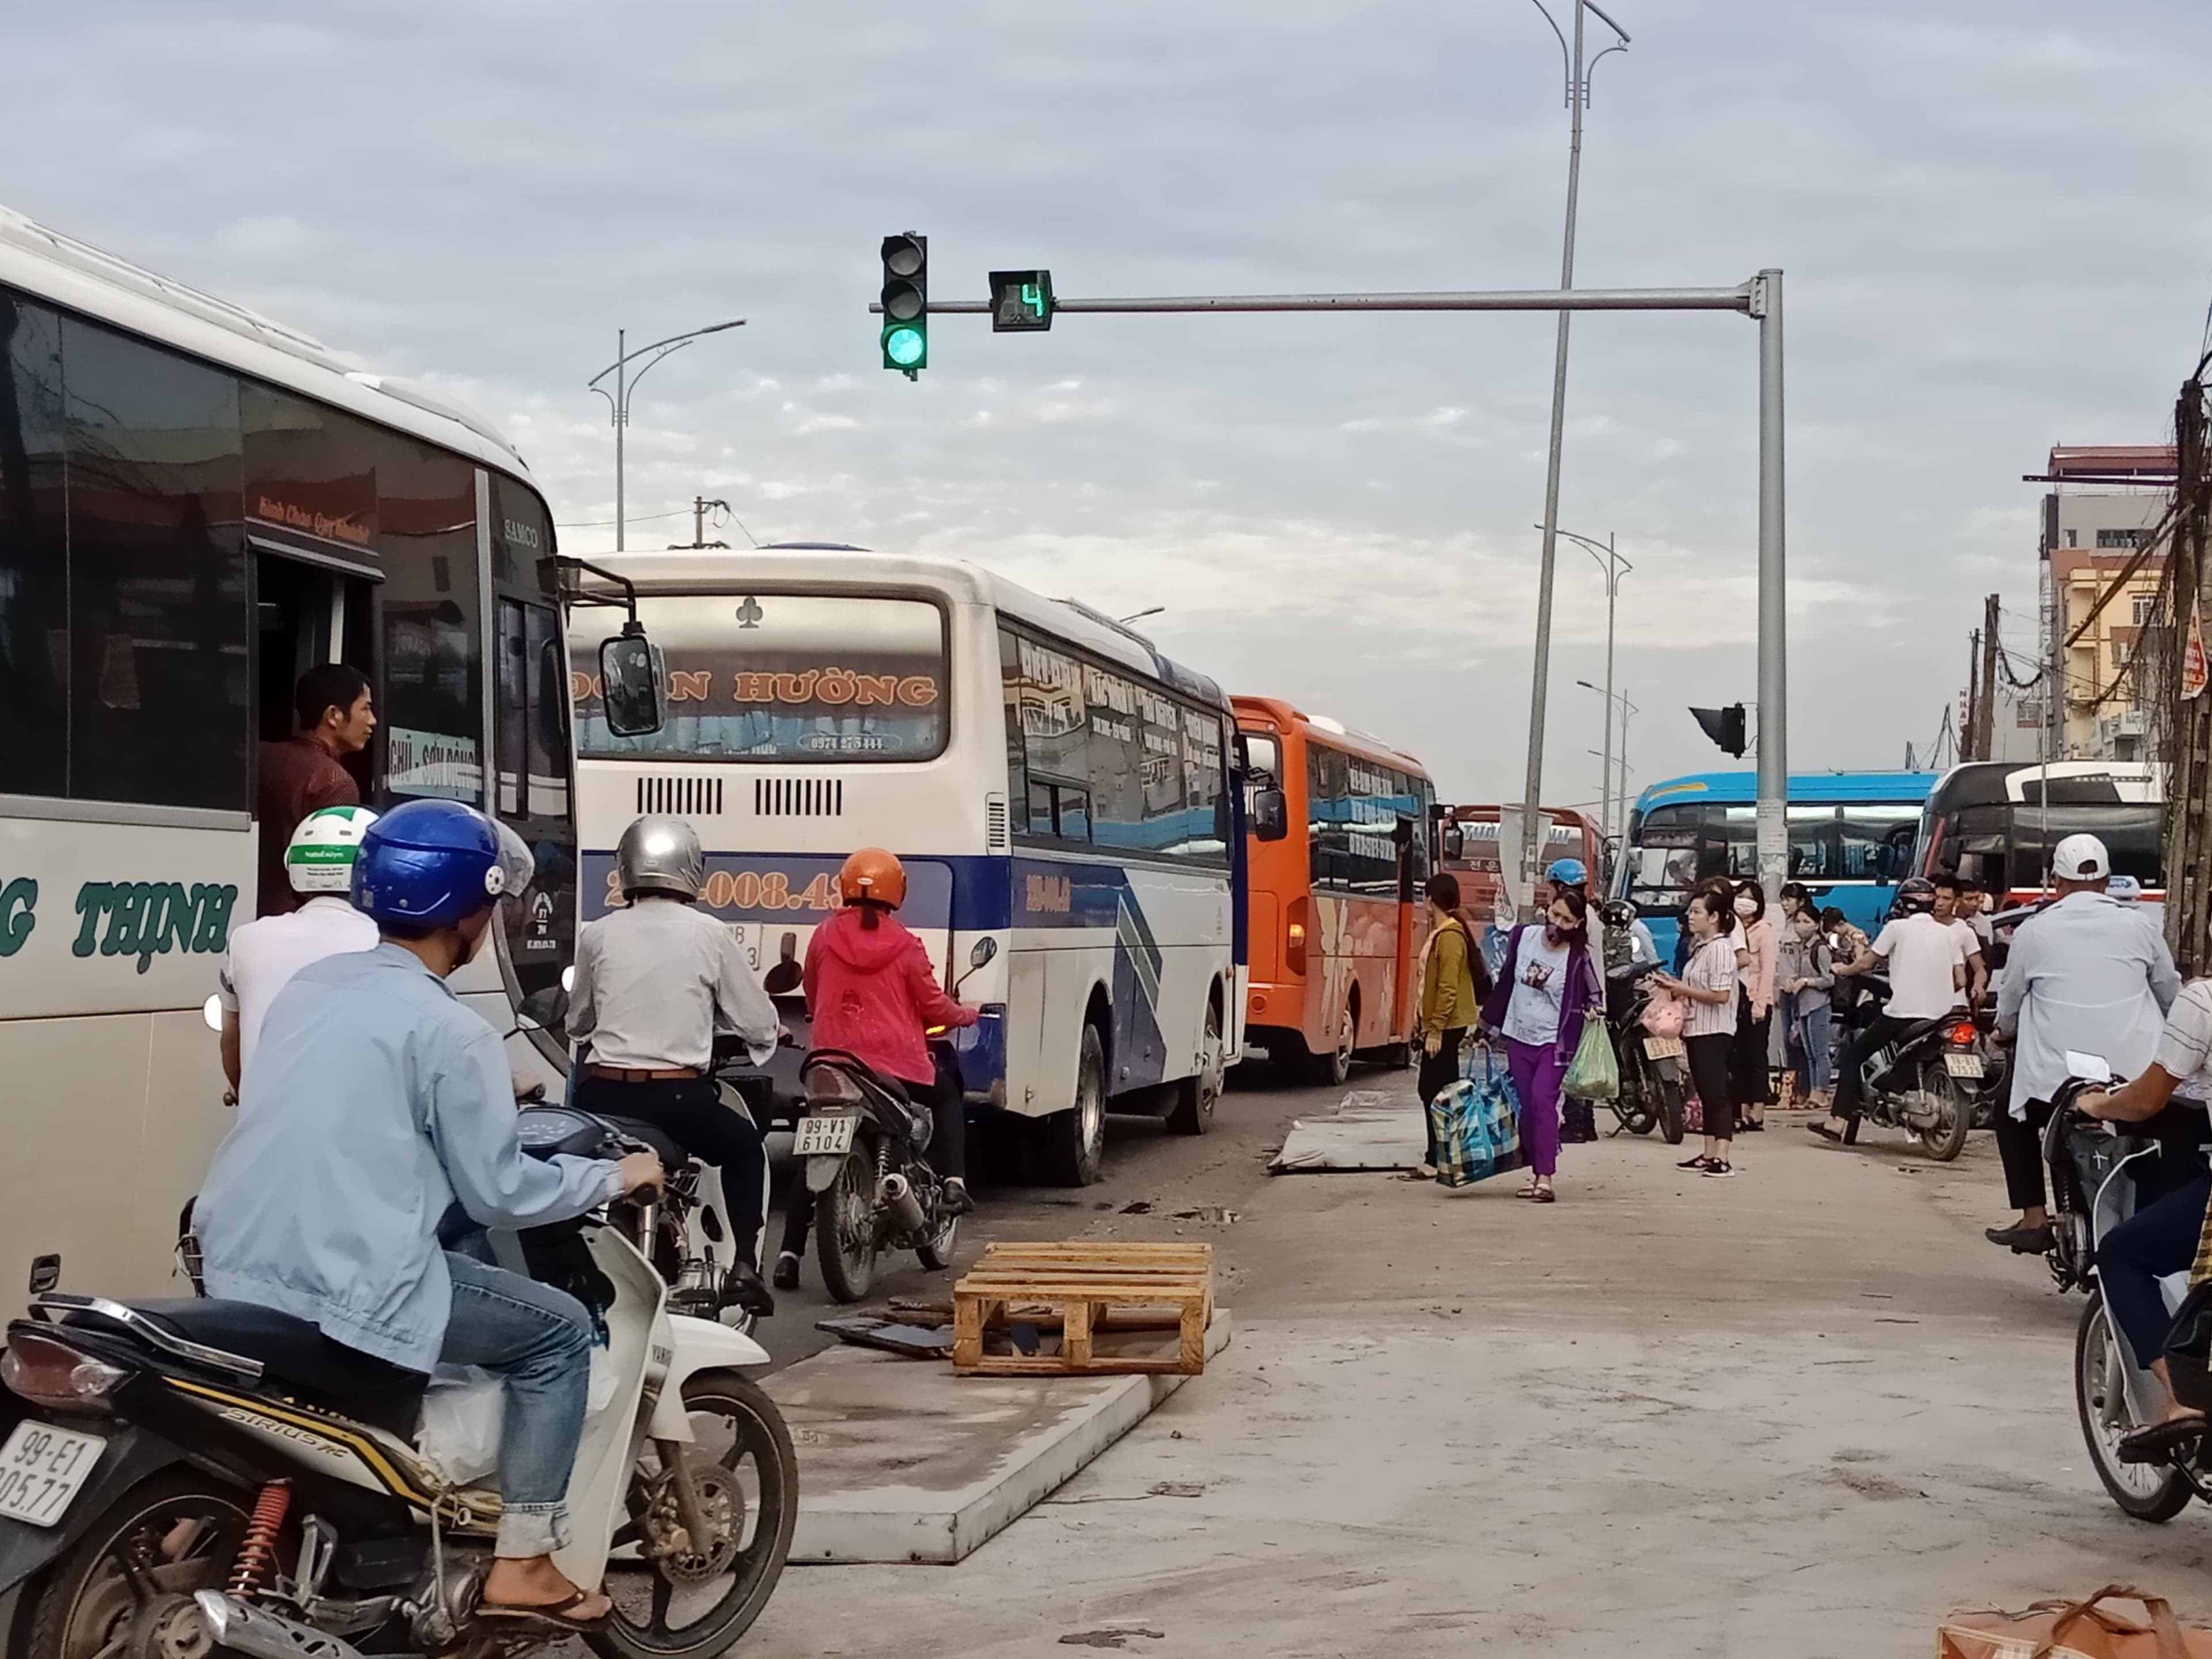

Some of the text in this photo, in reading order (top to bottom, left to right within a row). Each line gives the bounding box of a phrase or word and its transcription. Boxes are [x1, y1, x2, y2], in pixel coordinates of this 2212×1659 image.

[1022, 283, 1043, 317] 4
[734, 667, 938, 706] HƯỜNG
[72, 881, 238, 975] THỊNH
[802, 1135, 843, 1151] 6104
[226, 1407, 321, 1445] SIRIUS
[13, 1430, 87, 1476] 99-E1
